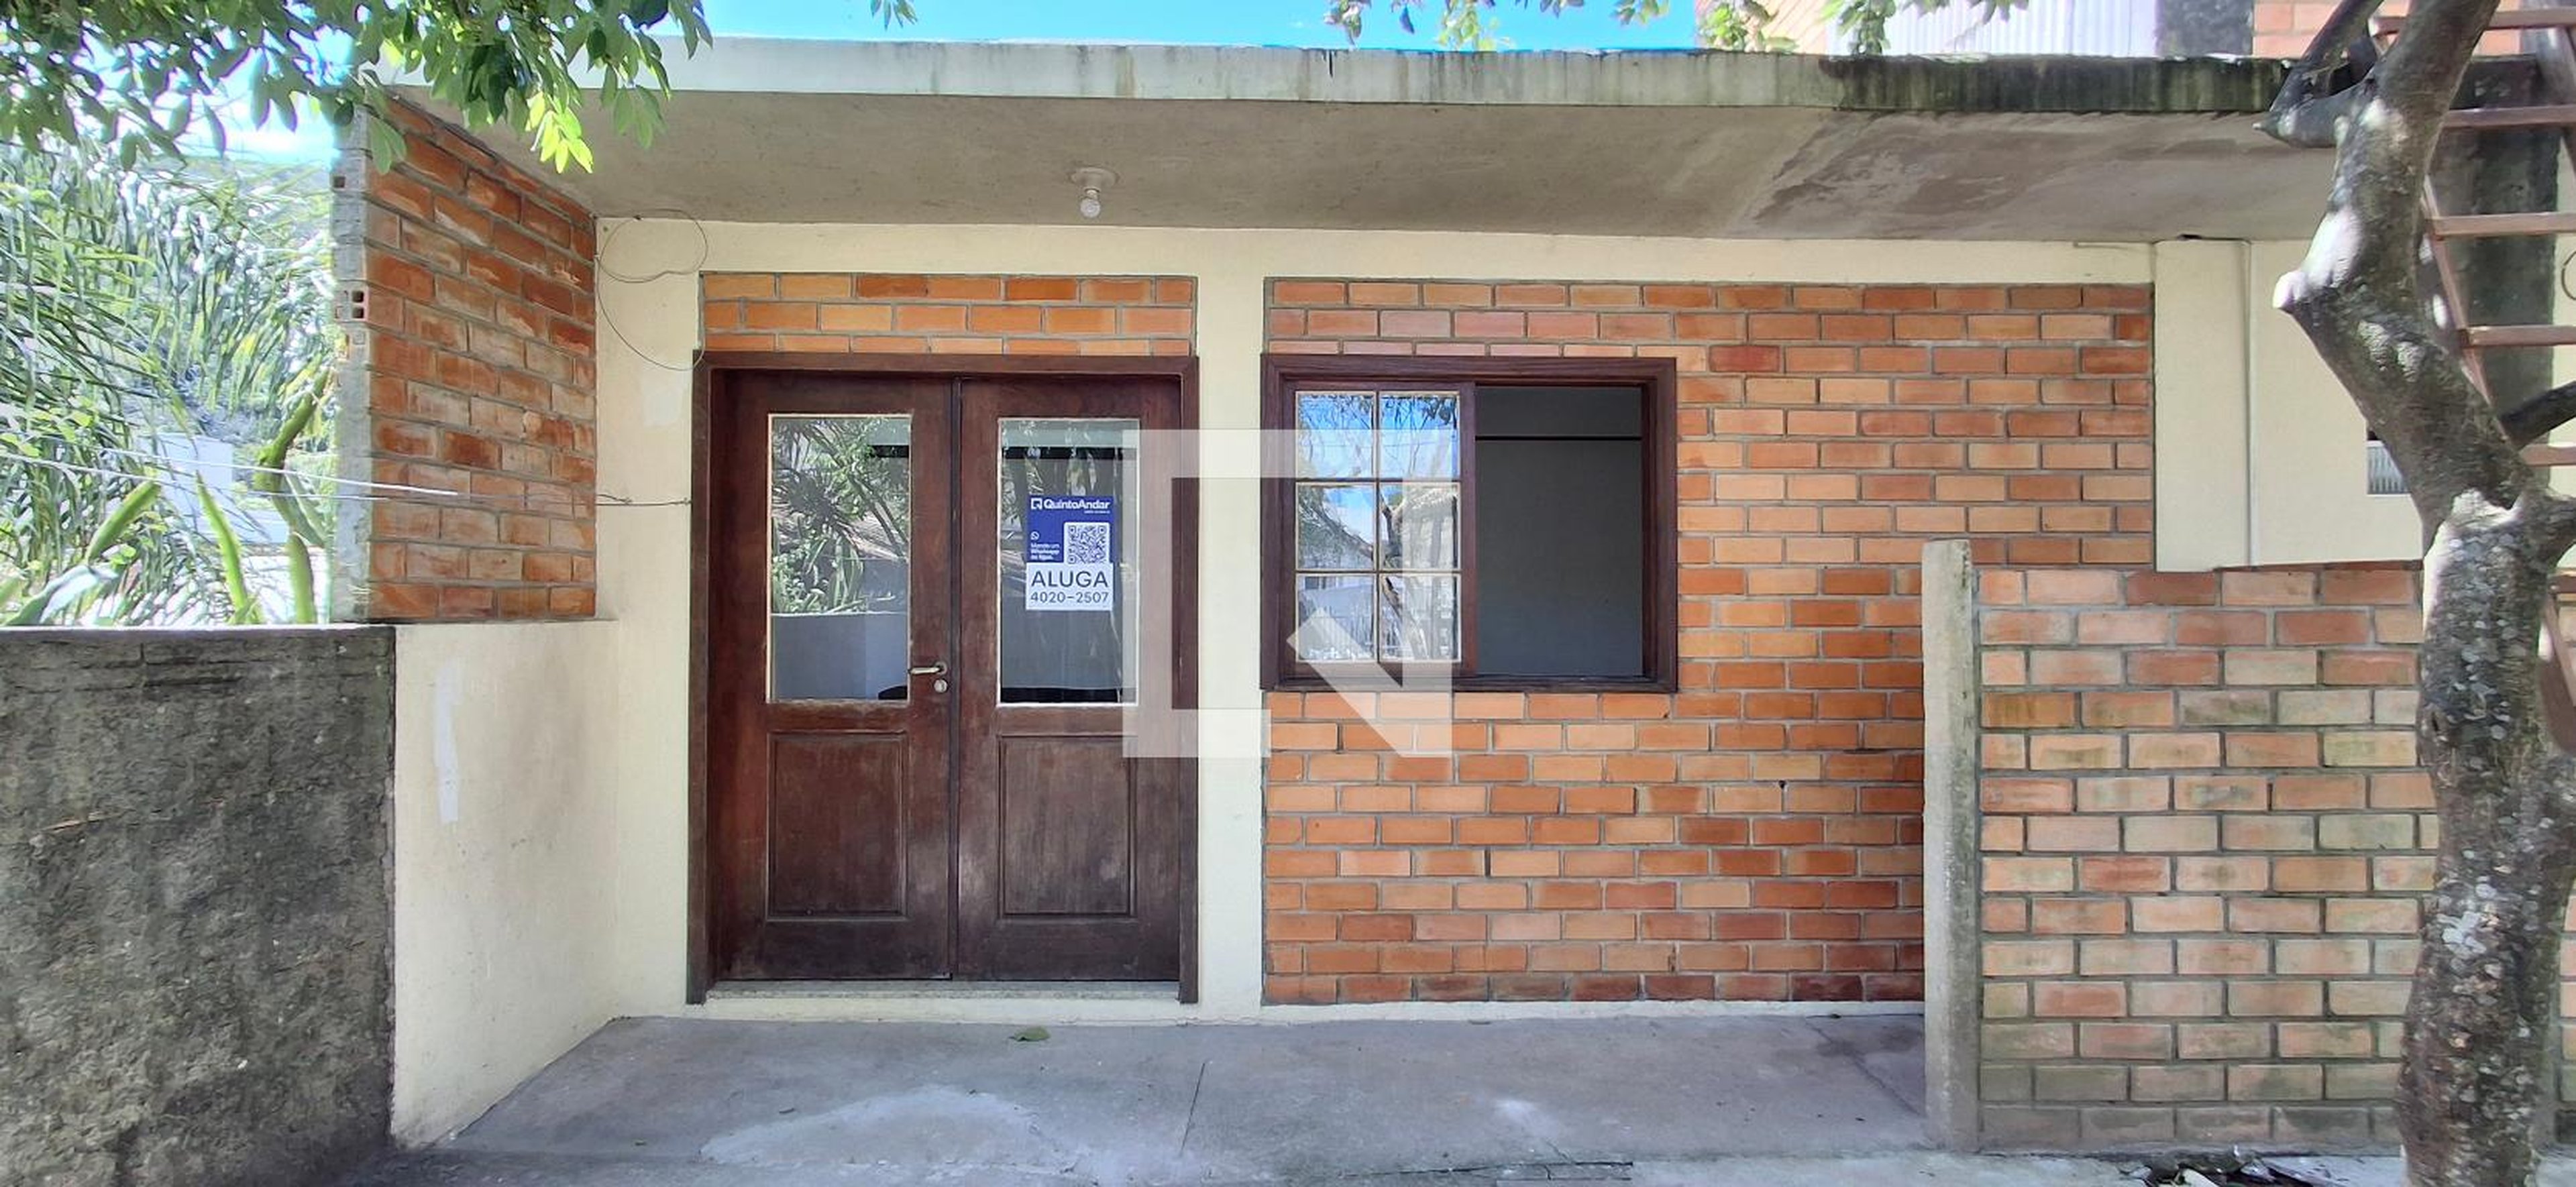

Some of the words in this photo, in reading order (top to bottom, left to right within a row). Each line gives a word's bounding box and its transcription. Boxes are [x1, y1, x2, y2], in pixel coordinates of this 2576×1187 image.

[1044, 499, 1110, 509] QuintoAndar
[1032, 571, 1108, 587] ALUGA
[1030, 591, 1109, 604] 4020-2507
